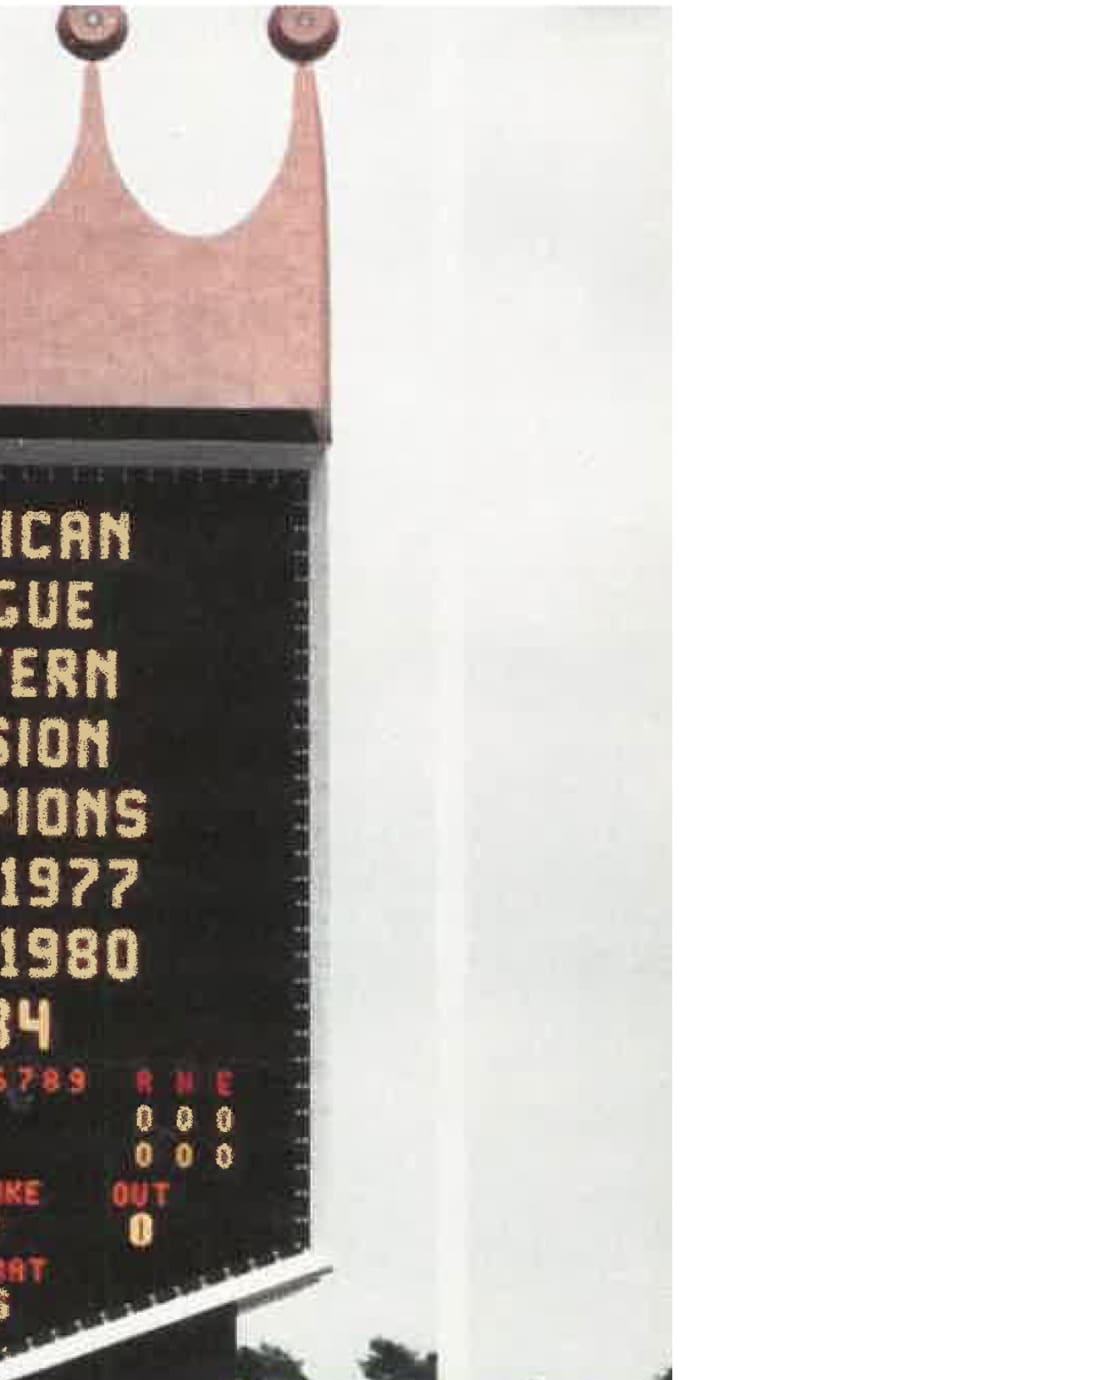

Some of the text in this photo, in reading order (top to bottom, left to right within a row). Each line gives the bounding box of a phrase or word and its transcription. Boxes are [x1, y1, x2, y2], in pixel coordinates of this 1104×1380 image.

[135, 1070, 153, 1094] R
[215, 1071, 234, 1096] E
[135, 1103, 234, 1133] 0 0 0
[134, 1140, 234, 1170] 0 0 0
[111, 1180, 171, 1208] OUT
[128, 1211, 154, 1248] 0
